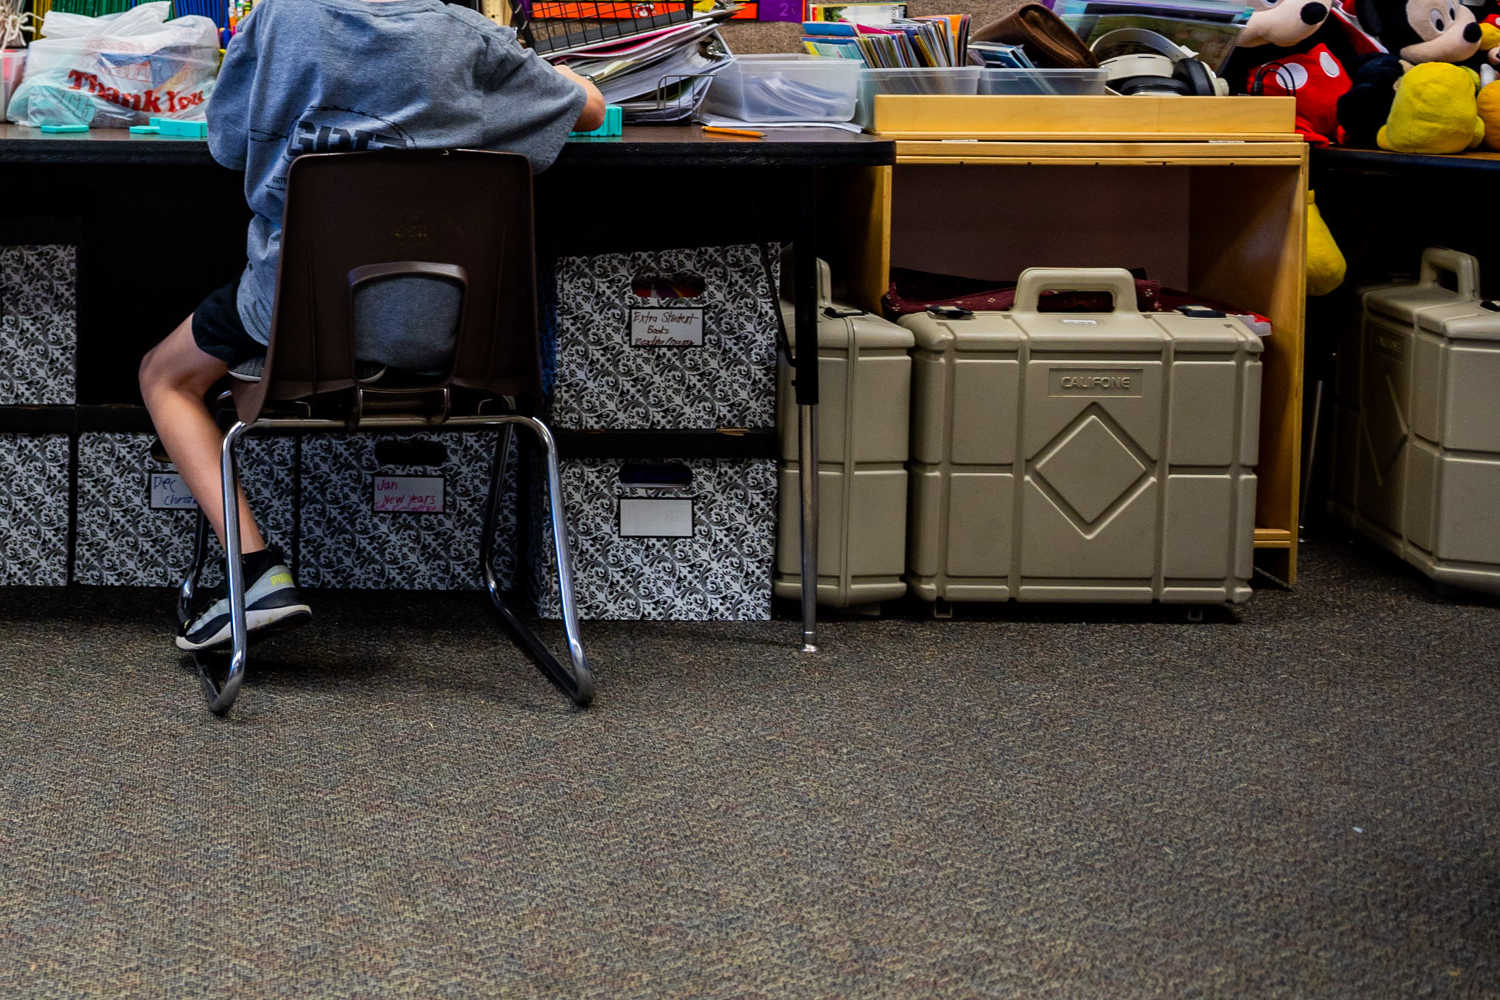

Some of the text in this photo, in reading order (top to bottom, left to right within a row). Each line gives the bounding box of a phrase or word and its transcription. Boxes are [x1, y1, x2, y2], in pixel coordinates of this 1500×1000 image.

[68, 69, 204, 113] Thank You
[1061, 375, 1131, 391] CALIFONE
